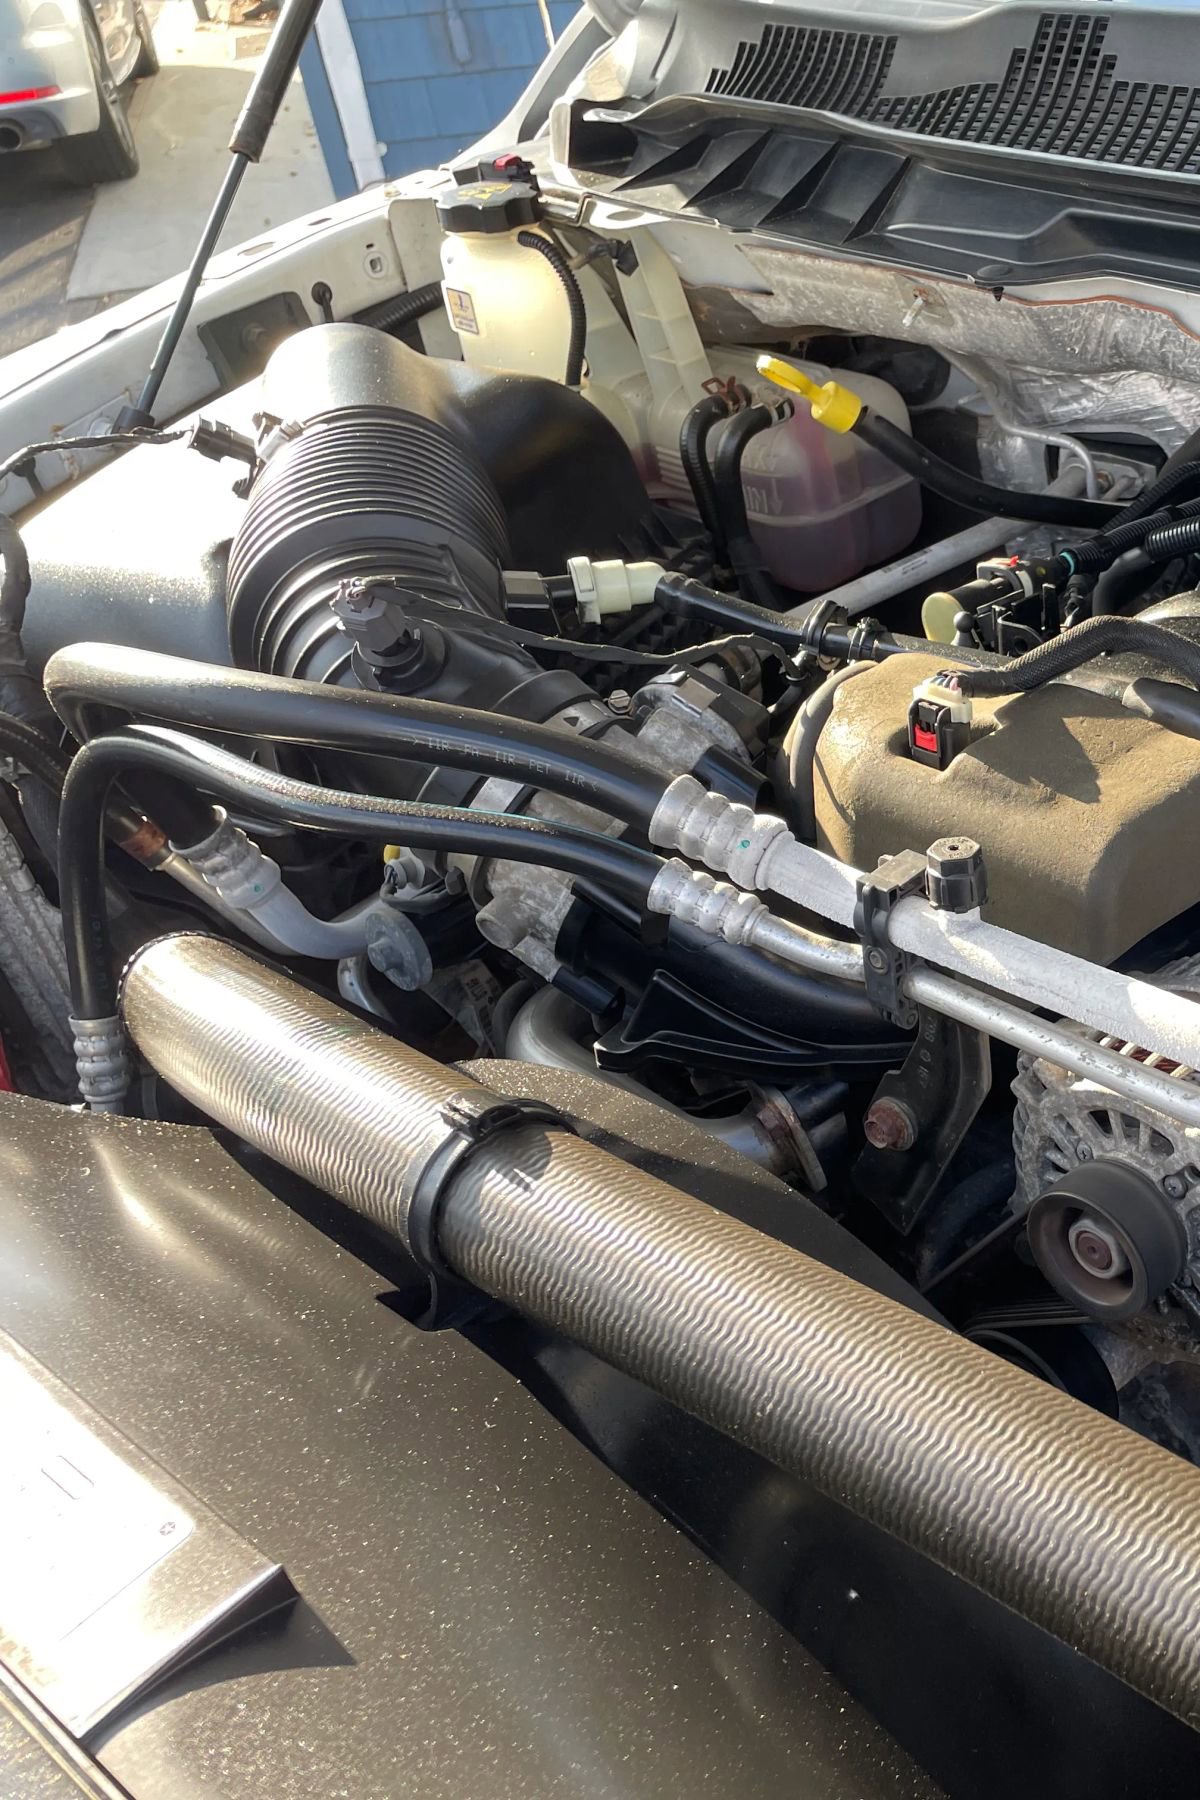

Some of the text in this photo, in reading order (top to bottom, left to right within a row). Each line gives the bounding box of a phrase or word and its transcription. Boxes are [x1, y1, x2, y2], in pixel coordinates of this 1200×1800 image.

[743, 483, 768, 514] IN
[495, 750, 515, 765] IIR
[529, 759, 552, 774] PET
[565, 770, 585, 787] IIR
